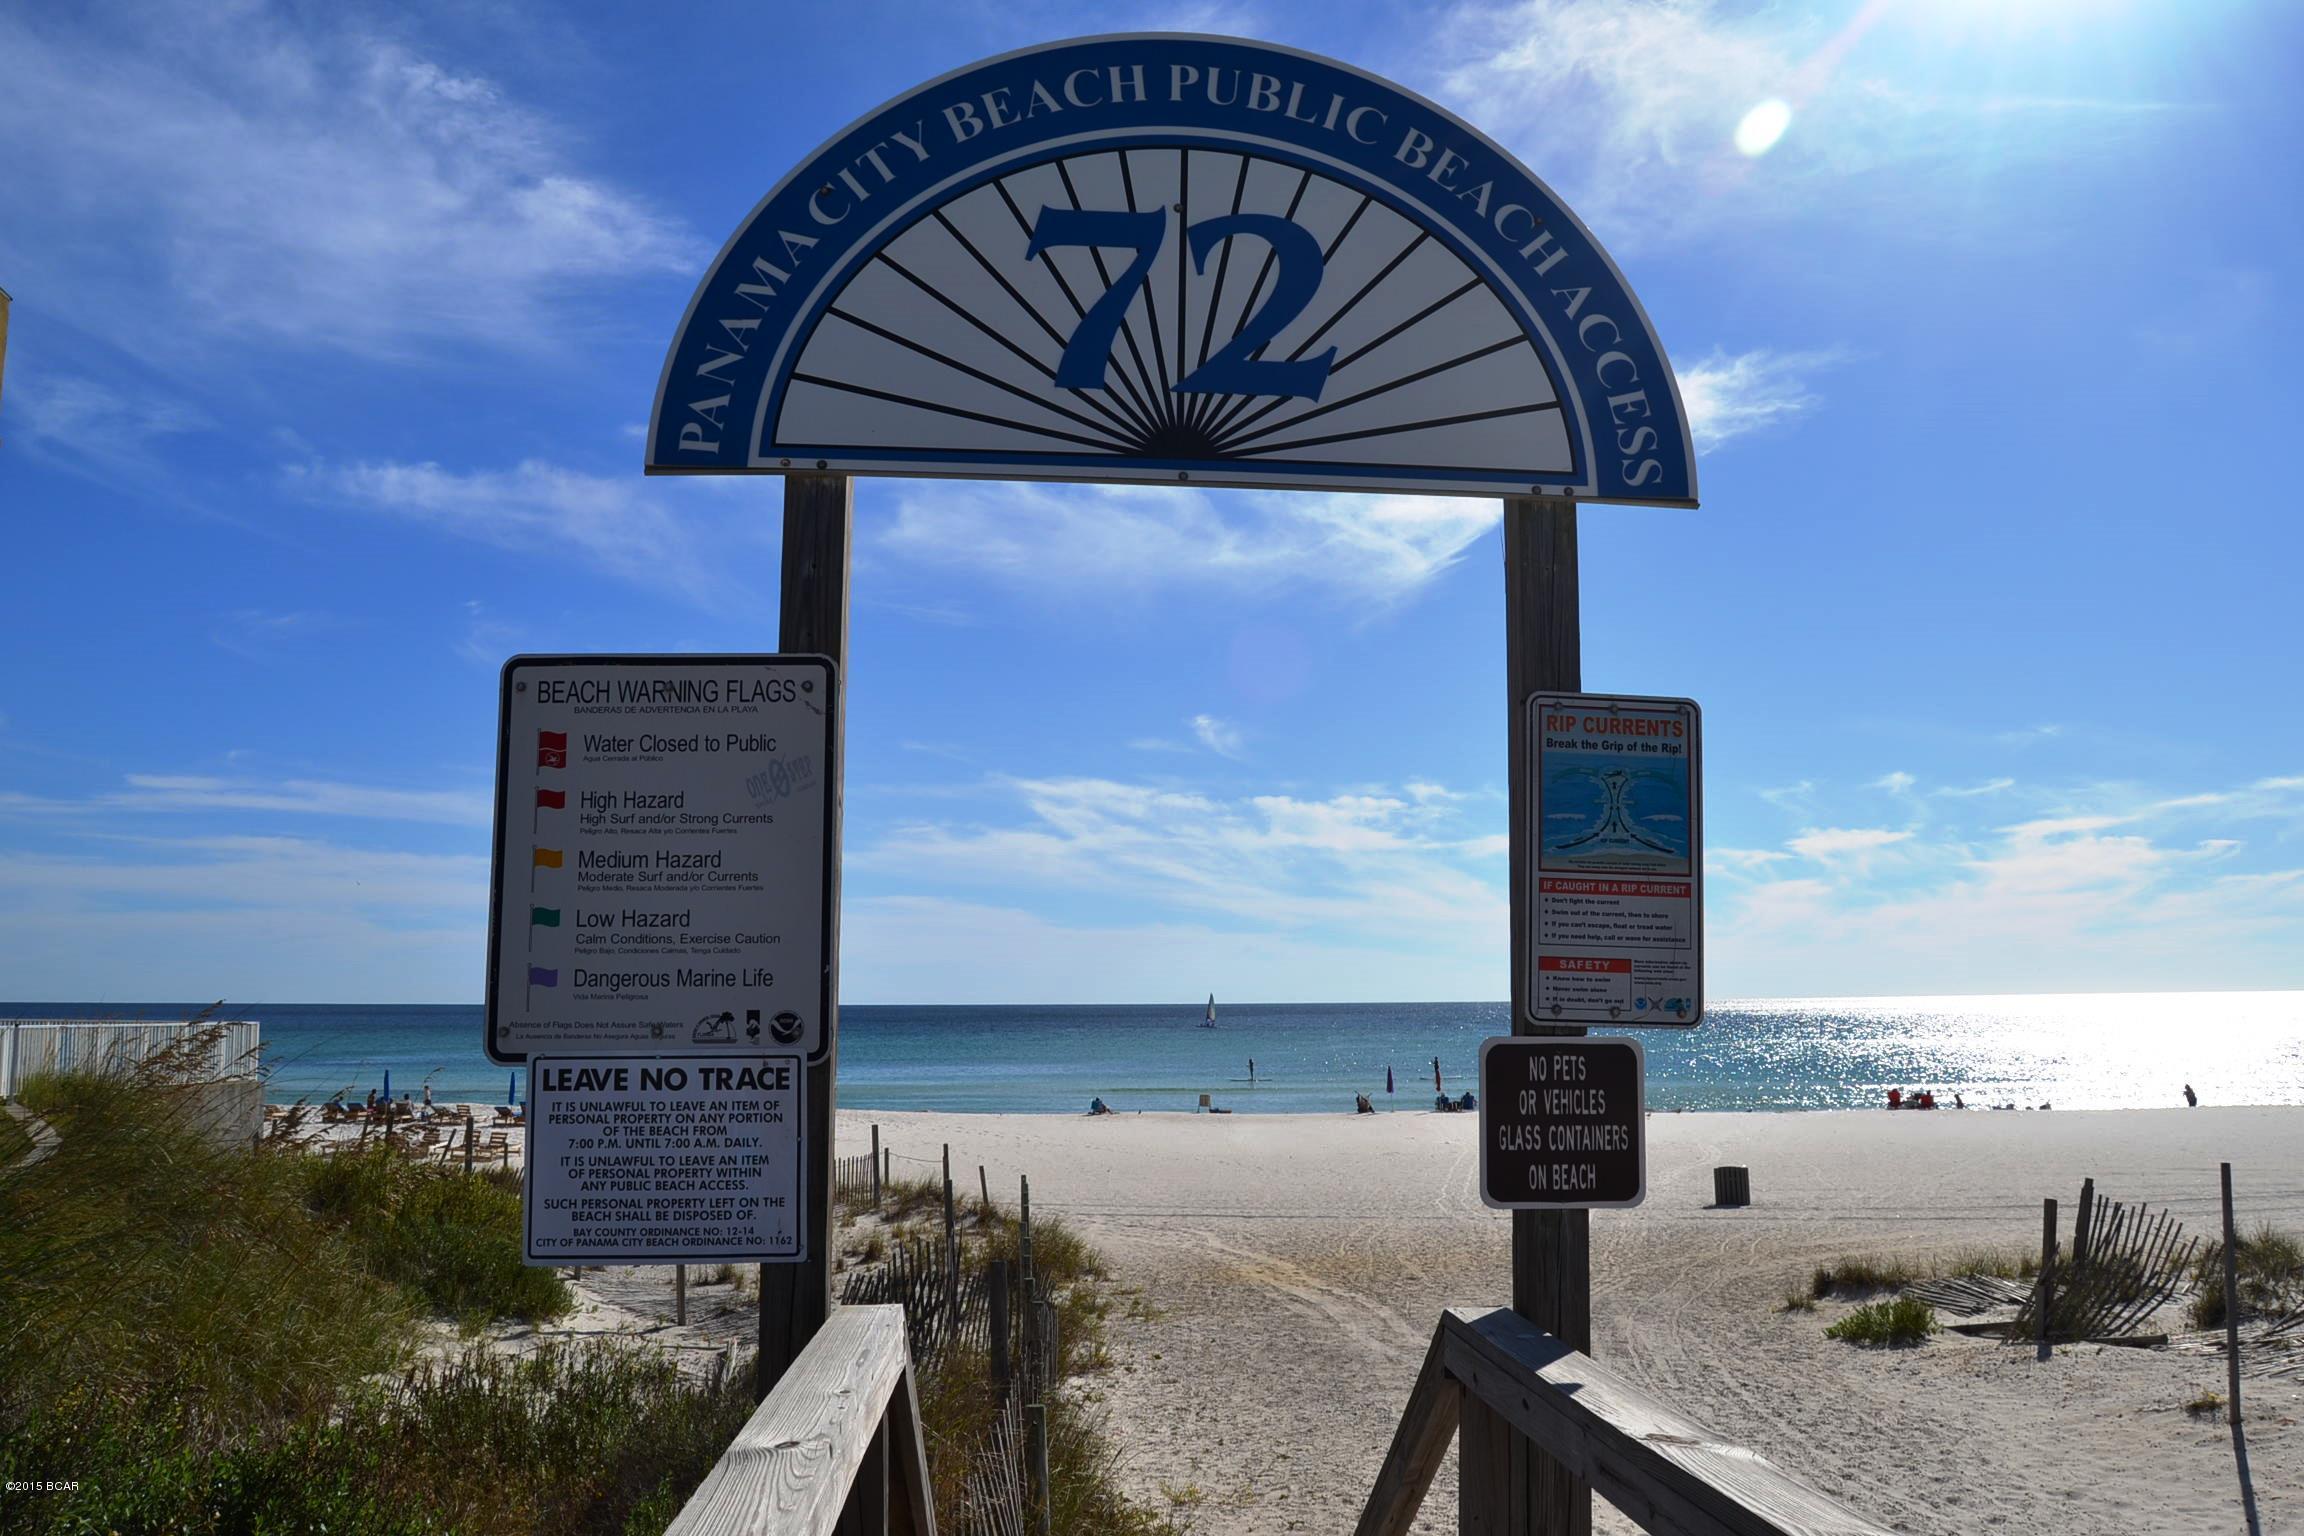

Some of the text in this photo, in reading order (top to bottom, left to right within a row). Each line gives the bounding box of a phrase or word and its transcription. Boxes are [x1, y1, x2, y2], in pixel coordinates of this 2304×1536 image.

[678, 64, 1663, 487] PANAMA CITY BEACH PUBLIC BEACH ACCESS
[1025, 204, 1338, 404] 72
[537, 679, 796, 703] BEACH WARNING FLAGS
[573, 705, 759, 714] BANDERAS DE ADVERTENCIA EN LA PLAYA
[1546, 714, 1683, 737] RIP CURRENTS
[583, 733, 776, 752] Water Closed to Public
[1546, 737, 1682, 754] Break the Grip of the Rip!
[582, 755, 601, 763] Agua
[580, 790, 684, 813] High Hazard
[579, 812, 774, 826] High Surf and/or Strong Currents
[578, 850, 721, 868] Medium Hazard
[577, 870, 758, 882] Moderate Surf and/or Currents
[1543, 880, 1686, 894] IF CAUGHT IN A RIP CURRENT
[1551, 896, 1568, 904] Don't
[1568, 897, 1583, 905] fight
[576, 909, 690, 927] Low Hazard
[575, 932, 780, 944] Calm Conditions, Exercise Caution
[1559, 959, 1610, 970] SAFETY
[573, 968, 773, 992] Dangerous Marine Life
[510, 1020, 542, 1029] Absence
[542, 1020, 551, 1028] of
[552, 1020, 572, 1030] Flags
[574, 1020, 594, 1029] Does
[595, 1021, 609, 1029] Not
[1529, 1055, 1586, 1080] NO PETS
[542, 1066, 790, 1091] LEAVE NO TRACE
[551, 1100, 780, 1112] IT IS UNLAWFUL TO LEAVE AN ITEM OF
[1519, 1089, 1606, 1115] OR VEHICLES
[548, 1112, 783, 1124] PERSONAL PROPERTY ON ANY PORTION
[602, 1125, 727, 1136] OF THE BEACH FROM
[1499, 1124, 1628, 1150] GLASS CONTAINERS
[568, 1137, 762, 1149] 7:00 P.M. UNTIL 7:00 A.M. DAILY.
[560, 1154, 769, 1167] IT IS UNLAWFUL TO LEAVE AN ITEM
[568, 1167, 762, 1179] OF PERSONAL PROPERTY WITHIN
[1528, 1163, 1595, 1190] ON BEACH
[580, 1179, 748, 1191] ANY PUBLIC BEACH ACCESS.
[543, 1196, 785, 1209] SUCH PERSONAL PROPERTY LEFT ON THE
[571, 1209, 756, 1221] BEACH SHALL BE DISPOSED OF.
[572, 1226, 754, 1237] BAY COUNTY ORDINANCE NO: 12-14
[536, 1235, 793, 1247] CITY OF PANAMA CITY BEACH ORDINANCE NO: 1162
